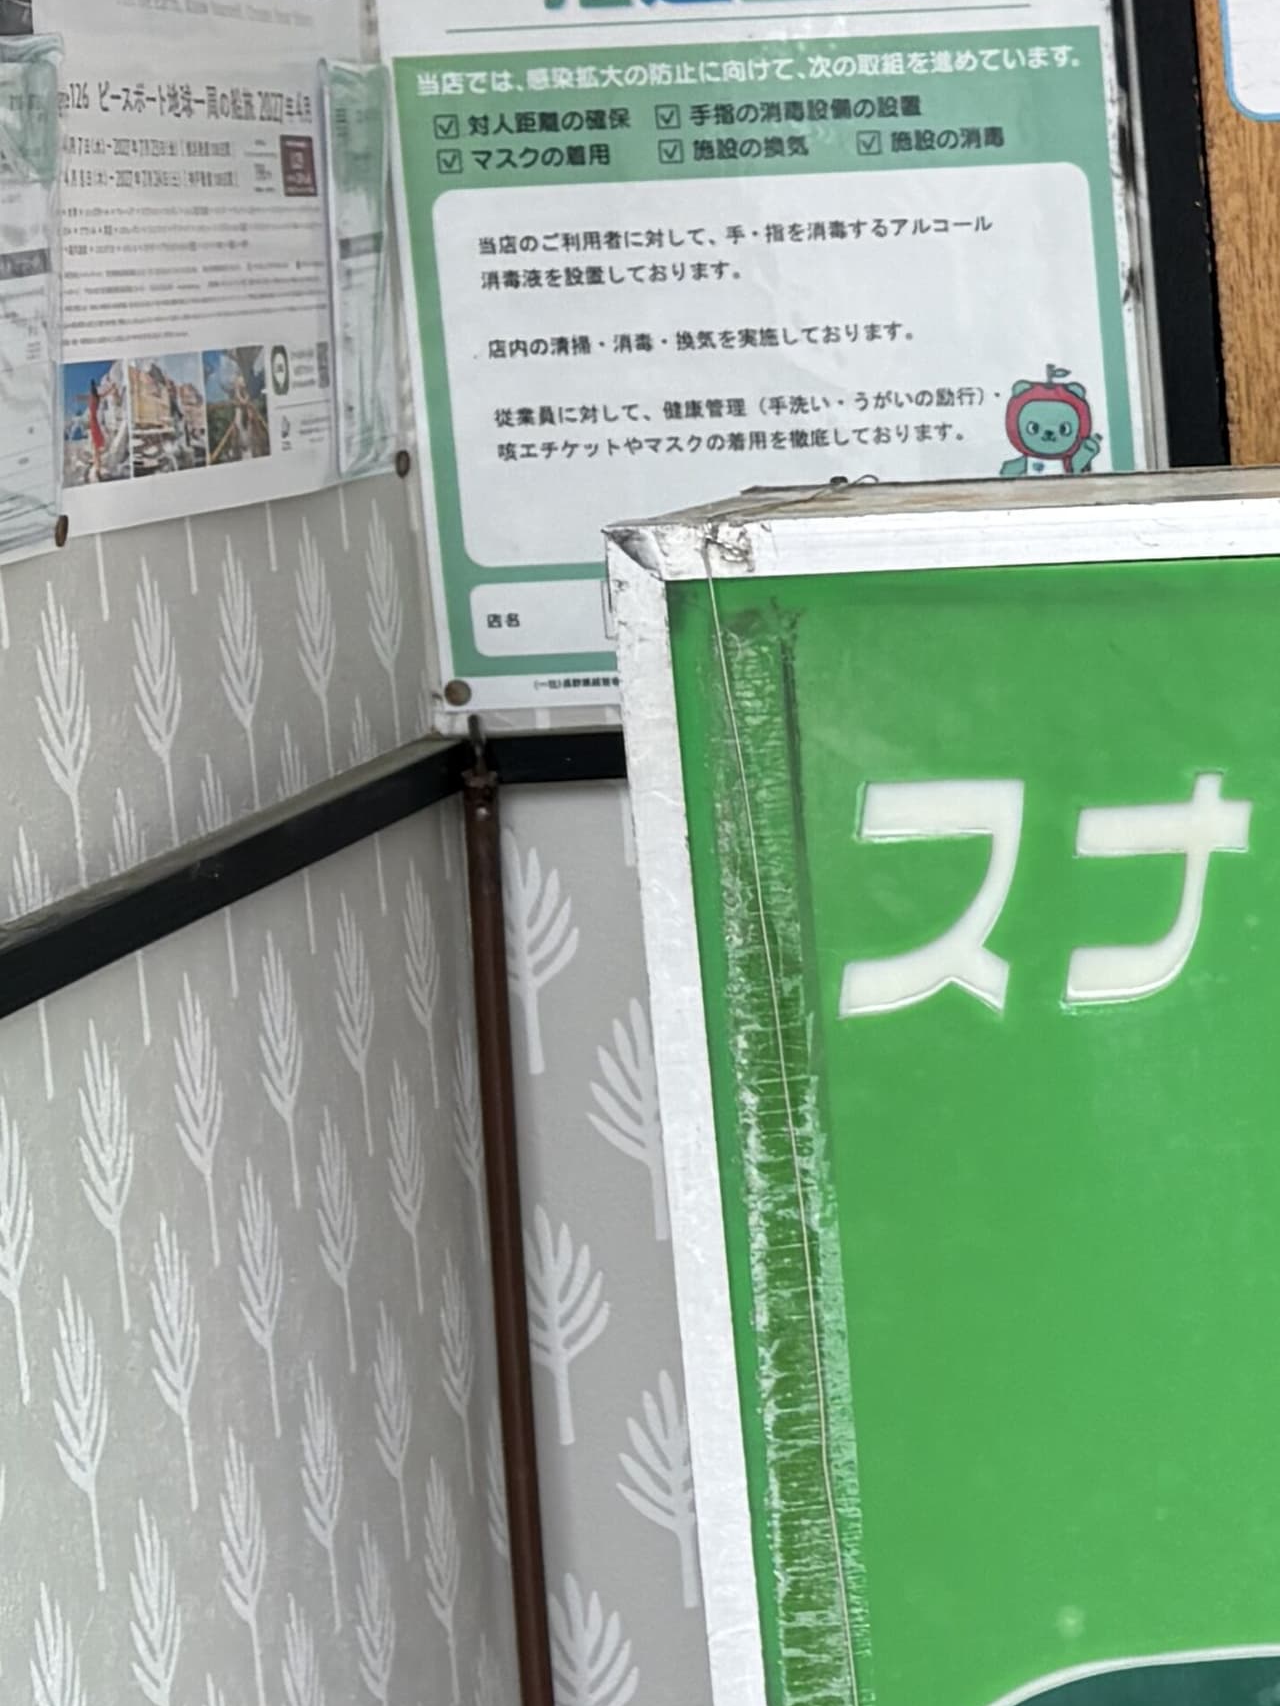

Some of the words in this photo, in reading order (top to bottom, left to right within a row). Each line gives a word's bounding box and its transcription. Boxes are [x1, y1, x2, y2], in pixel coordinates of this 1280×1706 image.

[416, 46, 1081, 96] 当店では、感染拡大の防止に向けて、次の取組を進めています。
[467, 106, 631, 136] 対人距離の確保
[690, 95, 922, 127] 手指の消毒設備の設置
[471, 140, 610, 169] マスクの着用
[692, 135, 809, 161] 施設の換気
[890, 125, 1005, 152] 施設の消毒
[478, 215, 993, 255] 当店のご利用者に対して、手・指を消毒するアルコール
[481, 260, 742, 290] 消毒液を設置しております。
[488, 323, 915, 359] 店内の清掃・消毒・換気を実施しております。
[497, 424, 967, 461] 咳エチケットやマスクの着用を徹底しております。
[486, 612, 522, 630] 店名
